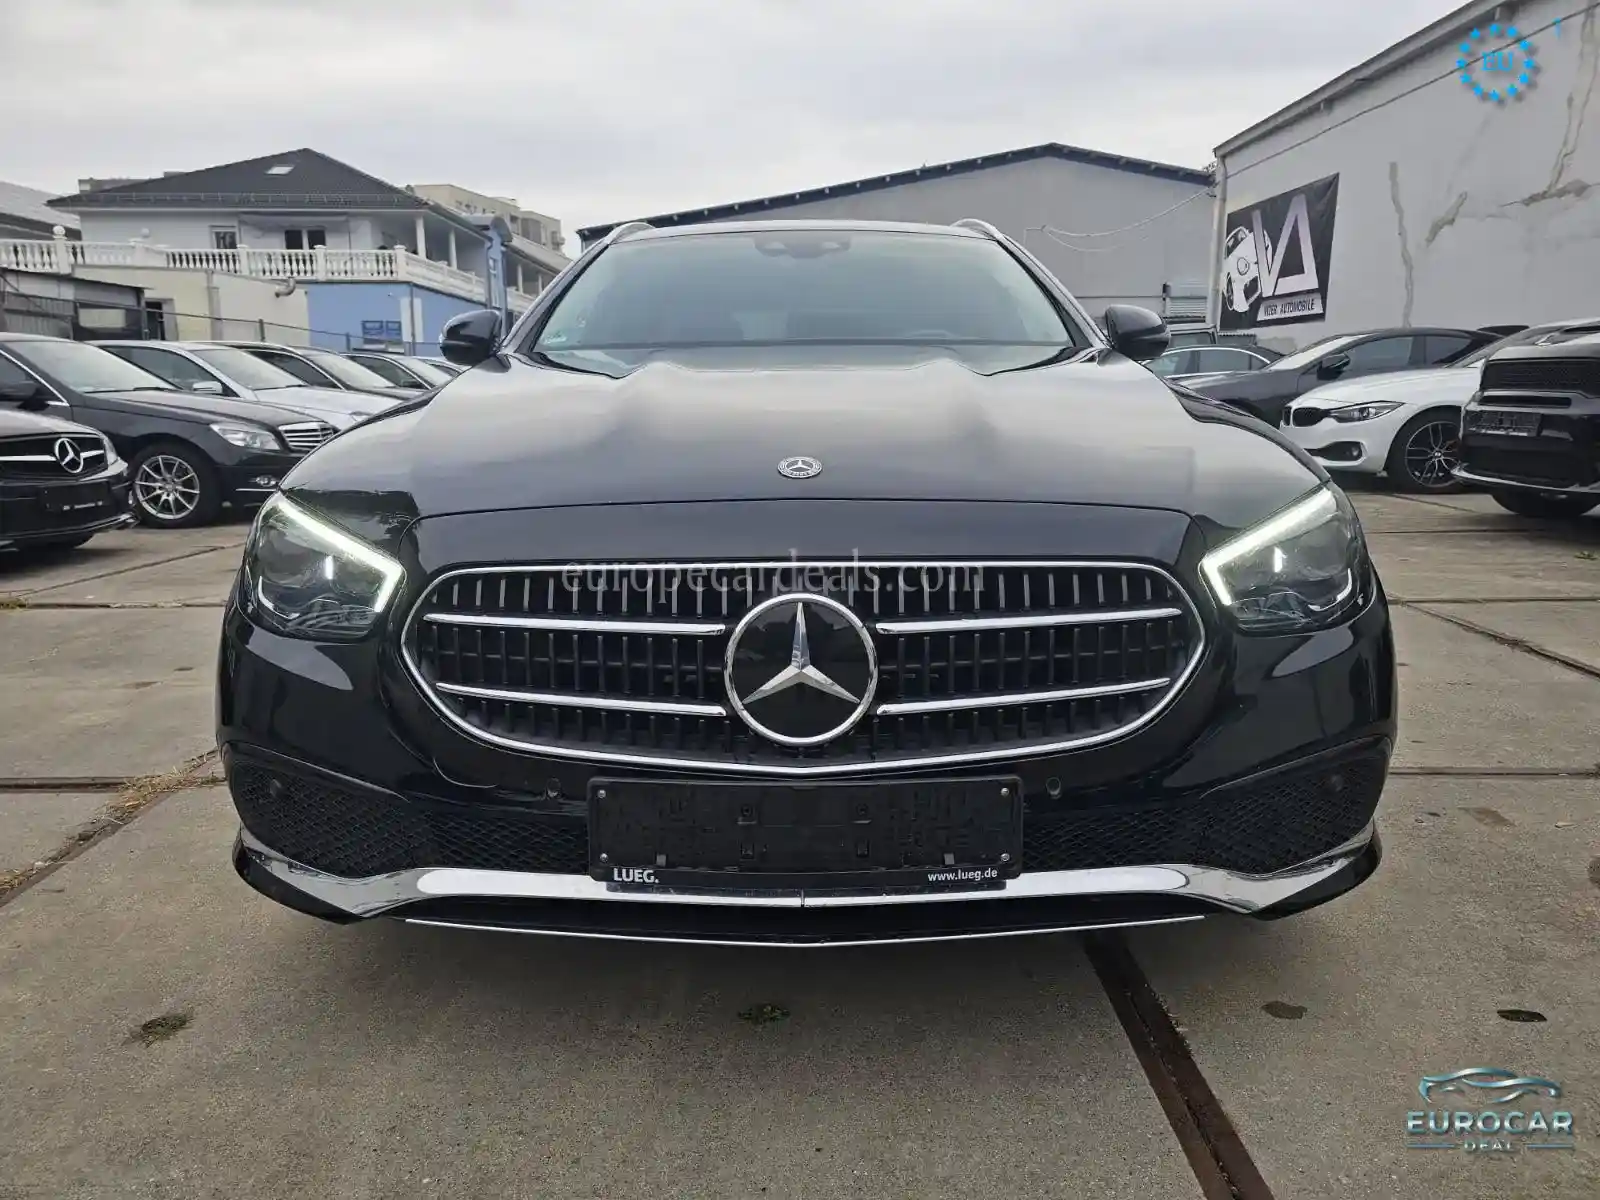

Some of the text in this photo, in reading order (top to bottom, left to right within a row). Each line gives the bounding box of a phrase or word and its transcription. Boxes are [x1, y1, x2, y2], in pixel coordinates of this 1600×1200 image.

[1280, 298, 1315, 314] AUTOMOBILE
[613, 867, 660, 883] LUEG.
[927, 867, 998, 882] www.lueg.de
